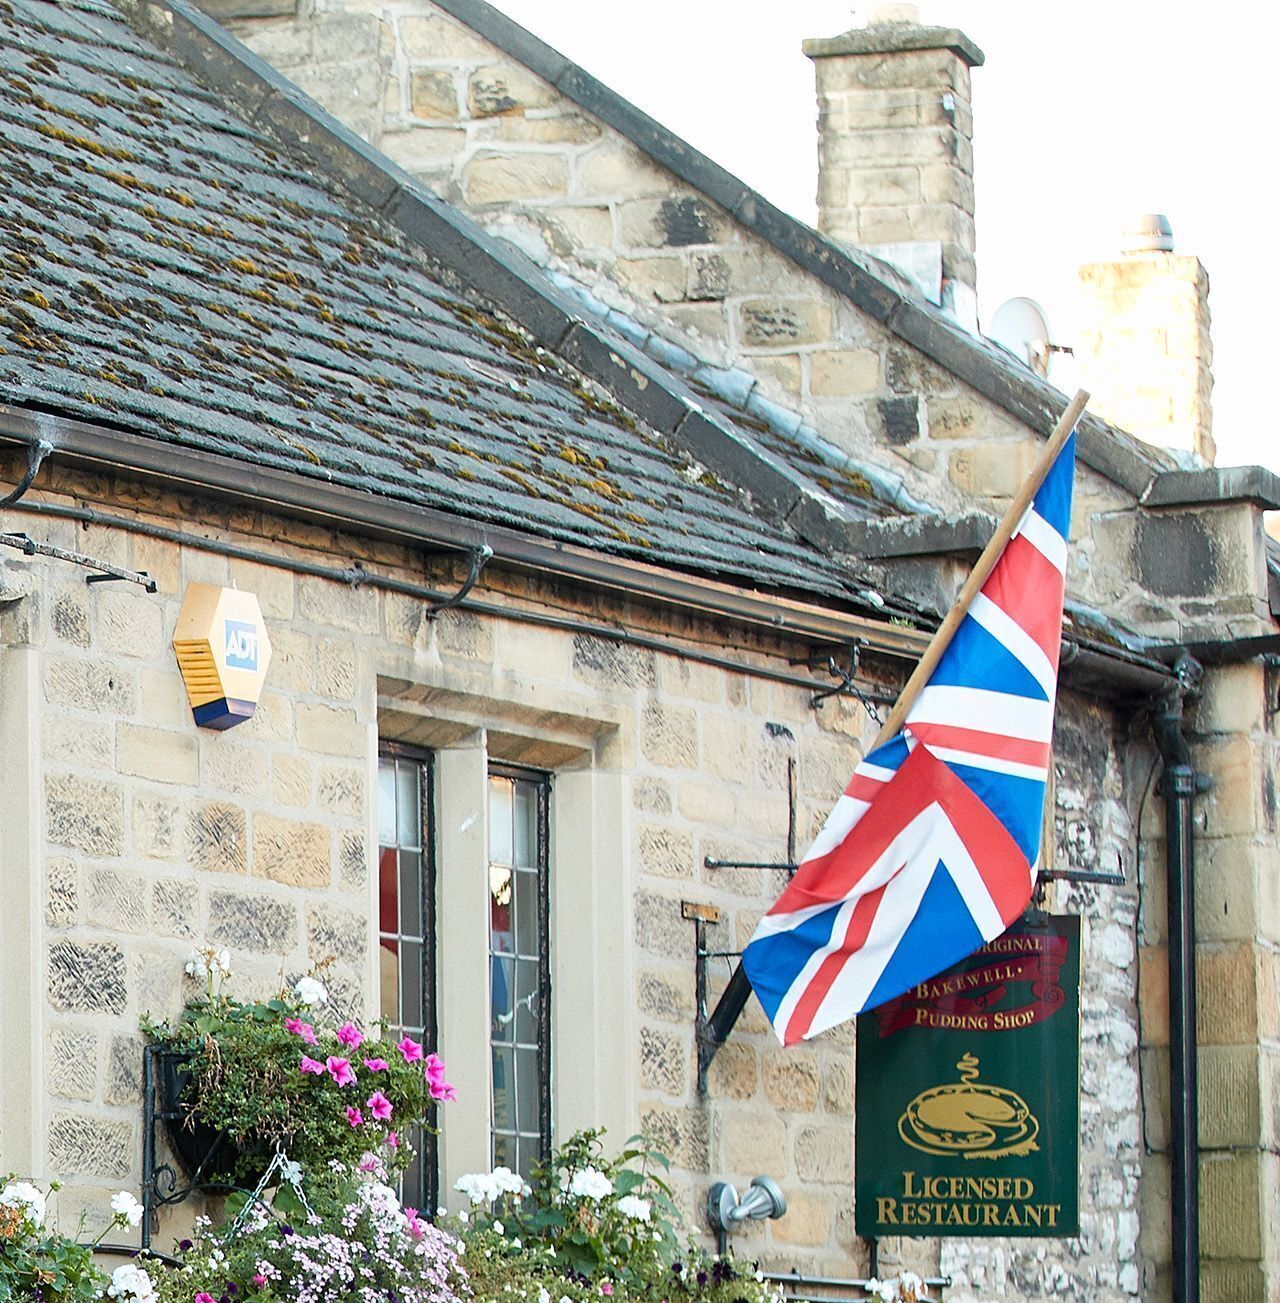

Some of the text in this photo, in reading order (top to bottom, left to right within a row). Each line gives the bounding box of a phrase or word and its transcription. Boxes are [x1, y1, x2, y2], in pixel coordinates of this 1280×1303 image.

[226, 628, 258, 662] ADT
[916, 965, 1015, 999] BAKEWELL
[915, 1008, 1035, 1029] PUDDING SHOP
[902, 1171, 1035, 1200] LICENSED
[876, 1197, 1061, 1228] RESTAURANT
